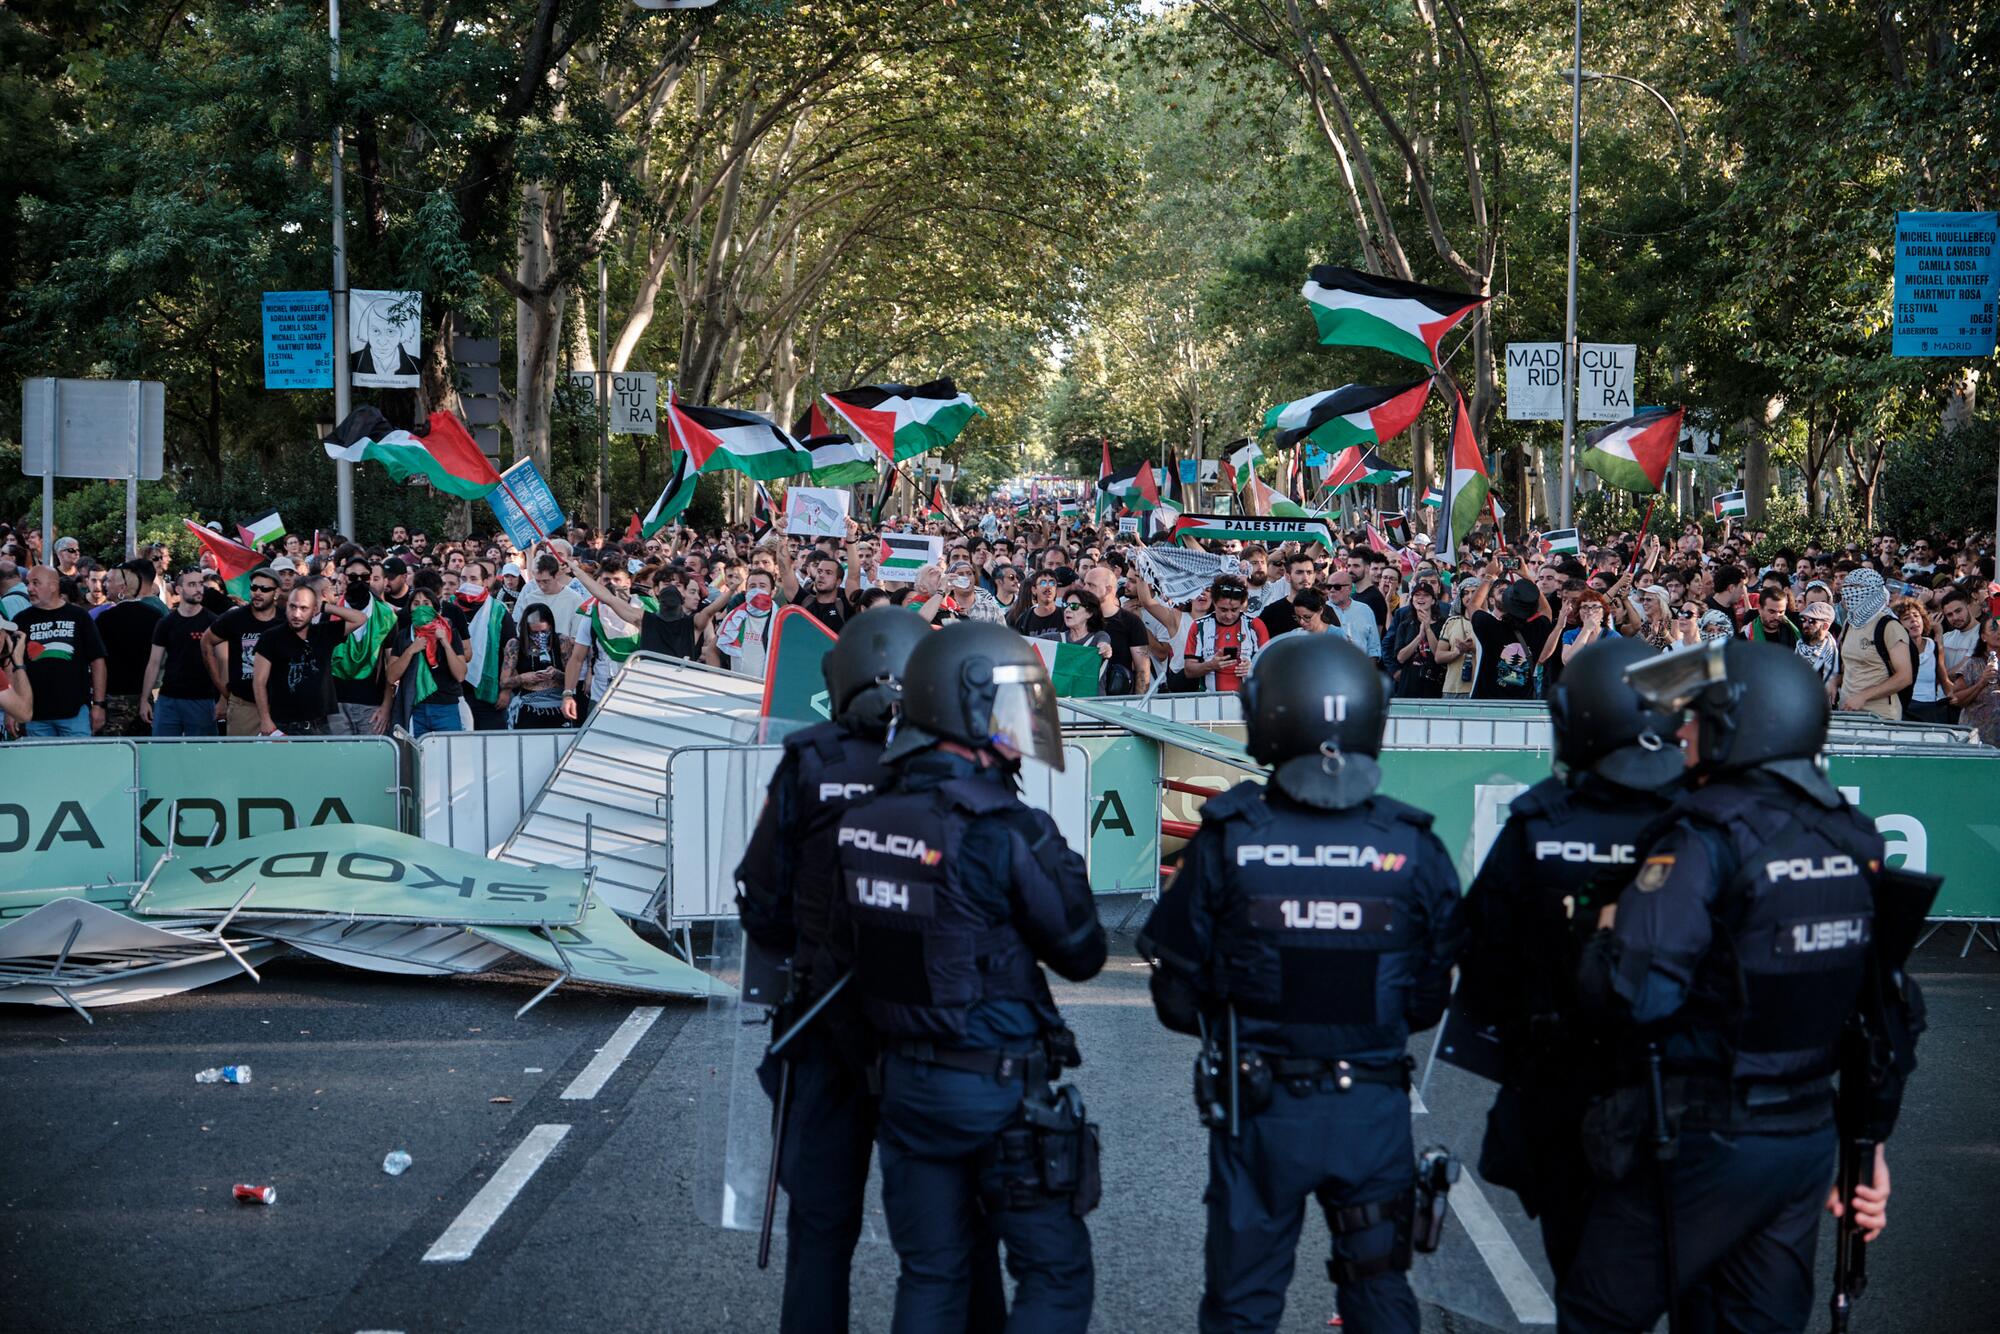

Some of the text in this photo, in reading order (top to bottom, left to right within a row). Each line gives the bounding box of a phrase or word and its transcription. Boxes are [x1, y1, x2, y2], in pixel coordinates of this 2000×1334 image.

[1900, 232, 1996, 244] MICHEL HOUELLEBECQ
[1905, 246, 1990, 256] ADRIANA CAVARERO
[1919, 260, 1977, 271] CAMILA SOSA
[1905, 275, 1989, 285] MICHAEL IGNATIEFF
[1914, 289, 1981, 299] HARTMUT ROSA
[266, 304, 328, 313] MICHEL HOUELLEBECQ
[1899, 304, 1993, 313] FESTIVAL DE
[270, 314, 294, 322] ADRIANA
[1899, 314, 1992, 323] LAS IDEAS
[1898, 327, 1938, 335] LABERINTOS
[1981, 327, 1992, 335] SEP
[1934, 342, 1972, 350] MADRID
[1508, 350, 1560, 367] MAD
[1583, 351, 1624, 368] CUL
[570, 376, 594, 389] AD
[1528, 369, 1560, 386] RID
[1589, 370, 1616, 387] TU
[614, 377, 647, 392] CUL
[619, 393, 640, 407] TU
[1603, 389, 1629, 406] RA
[630, 408, 652, 422] RA
[1225, 520, 1306, 532] PALESTINE
[30, 621, 75, 632] STOP THE
[30, 630, 74, 640] GENOCIDE
[838, 828, 926, 861] POLICIA
[1237, 845, 1382, 866] POLICIA
[1536, 841, 1636, 863] POLIC
[856, 877, 909, 912] 1U94
[1280, 901, 1362, 930] 1U90
